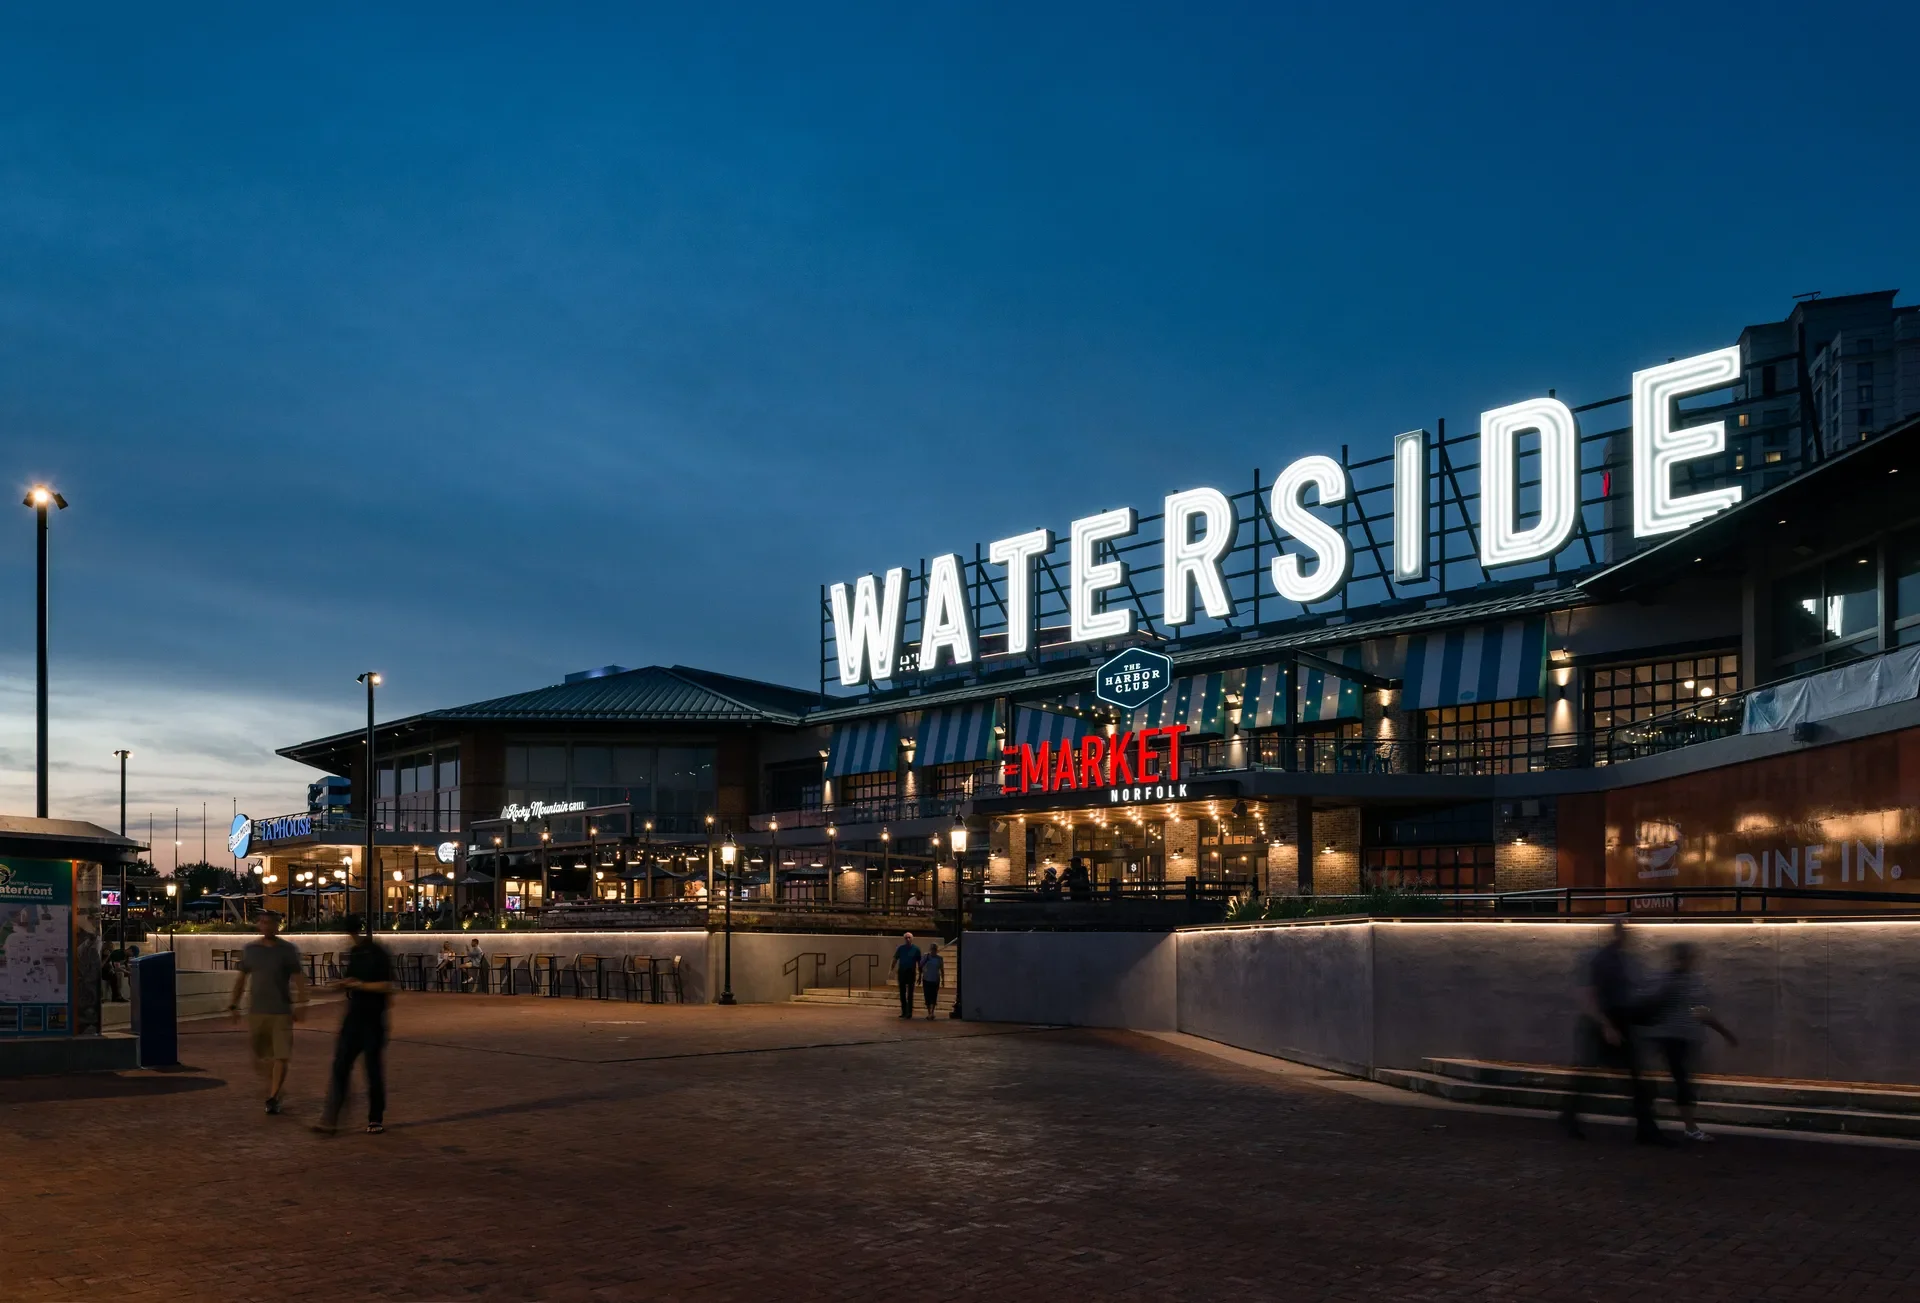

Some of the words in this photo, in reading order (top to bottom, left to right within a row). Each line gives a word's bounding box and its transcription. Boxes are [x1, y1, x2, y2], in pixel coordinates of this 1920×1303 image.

[829, 344, 1743, 686] WATERSIDE
[1123, 663, 1141, 671] THE
[1105, 670, 1160, 685] HARBOR
[1115, 681, 1149, 693] CLUB
[1021, 724, 1189, 793] MARKET
[1001, 745, 1020, 795] THE
[1110, 784, 1187, 802] NORFOLK
[507, 803, 531, 822] Rocky
[531, 801, 568, 818] Mountain
[569, 801, 584, 812] GRILL
[1735, 844, 1824, 889] DINE
[1841, 838, 1902, 882] IN.
[0, 885, 53, 896] aterfront
